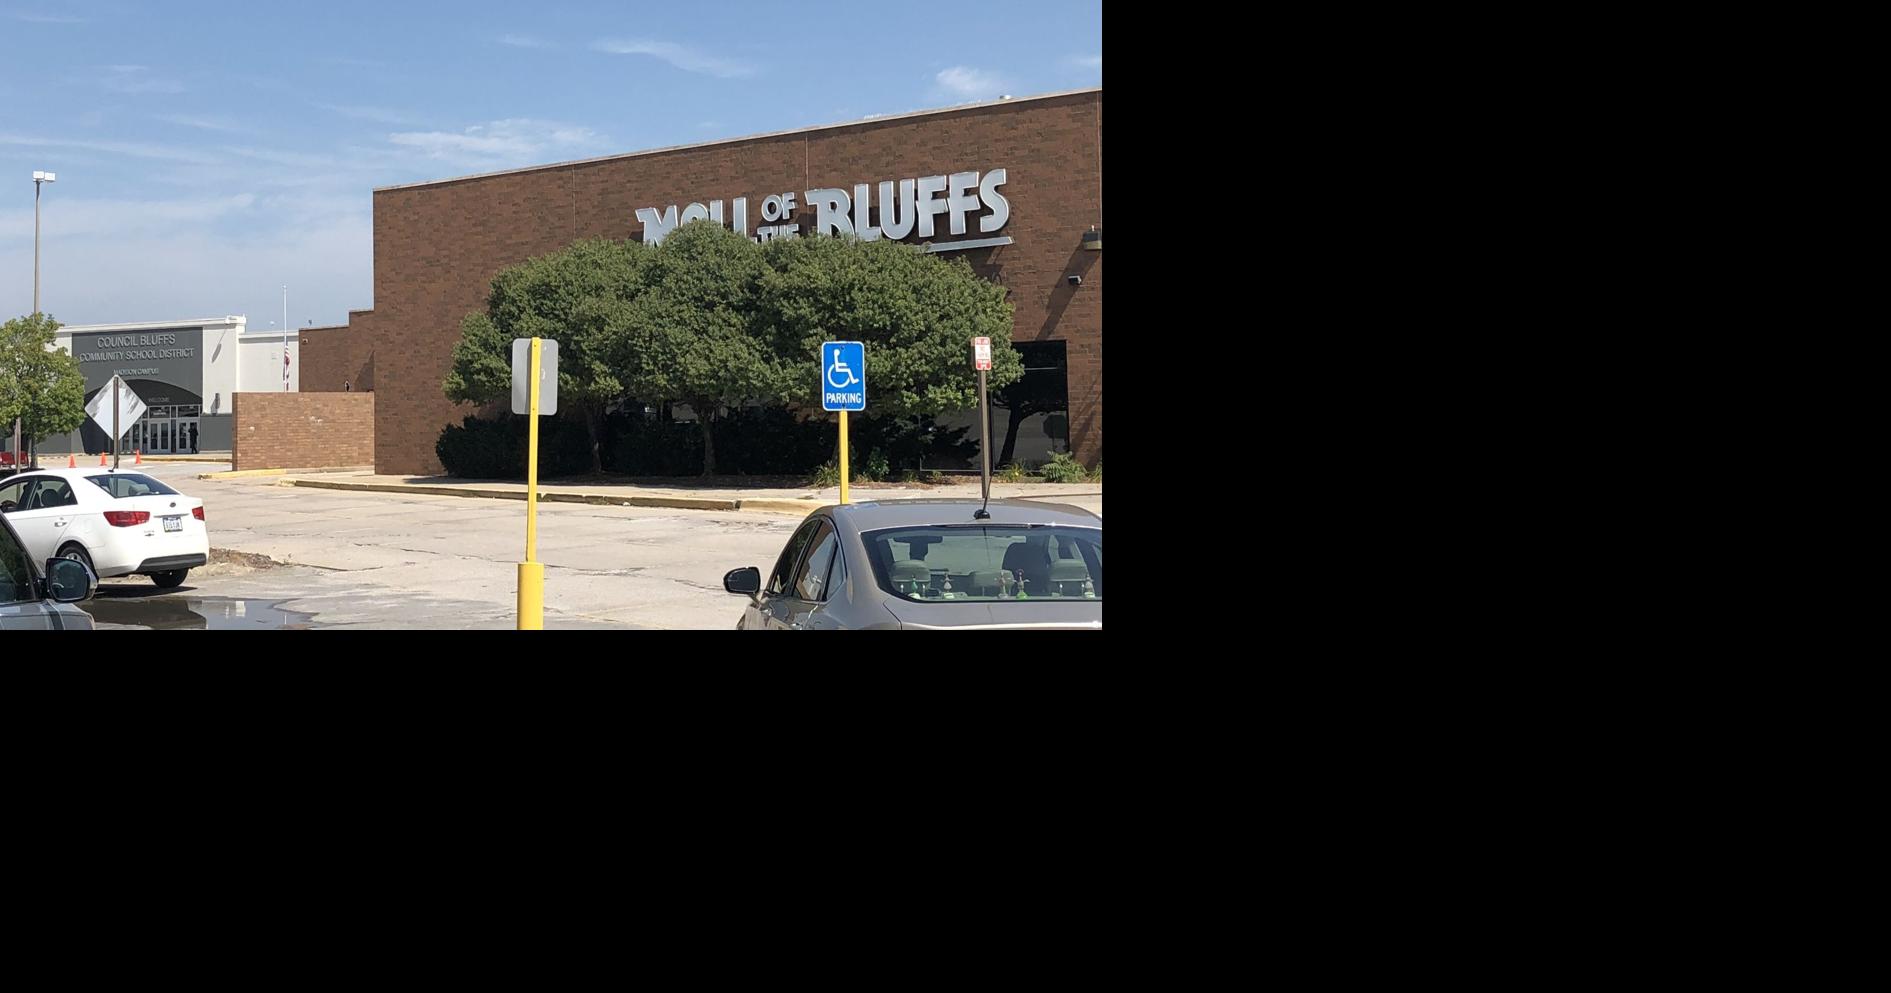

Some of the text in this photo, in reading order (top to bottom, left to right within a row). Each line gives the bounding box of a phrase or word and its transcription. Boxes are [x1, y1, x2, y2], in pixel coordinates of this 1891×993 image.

[761, 191, 796, 222] OF
[804, 168, 1010, 246] BLUFFS
[97, 333, 176, 348] COUNCIL BLUFFS
[79, 347, 195, 362] COMMUNITY SCHOOL DISTRICT
[826, 392, 862, 404] PARKING
